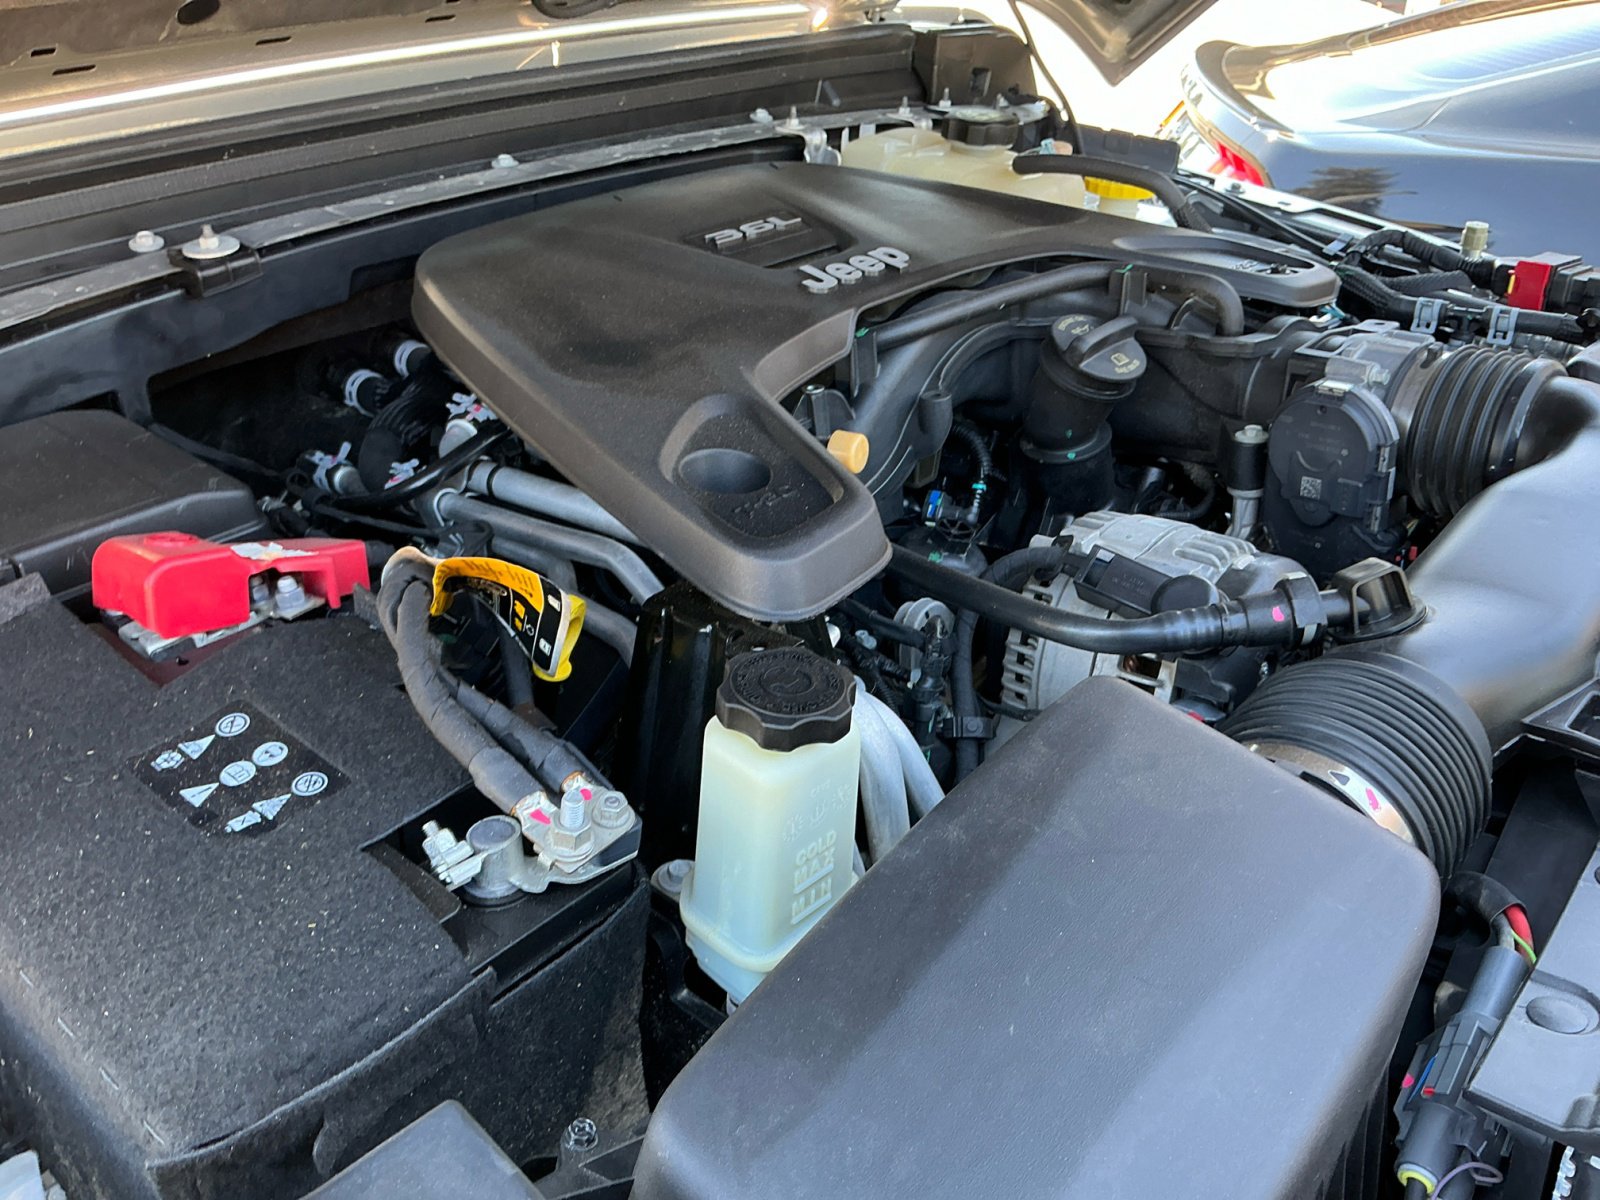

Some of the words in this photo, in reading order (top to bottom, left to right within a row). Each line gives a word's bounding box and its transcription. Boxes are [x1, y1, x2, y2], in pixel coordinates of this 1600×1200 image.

[798, 246, 911, 293] Jeep
[794, 847, 836, 889] MAX
[796, 829, 837, 867] COLD
[791, 877, 832, 920] MIN
